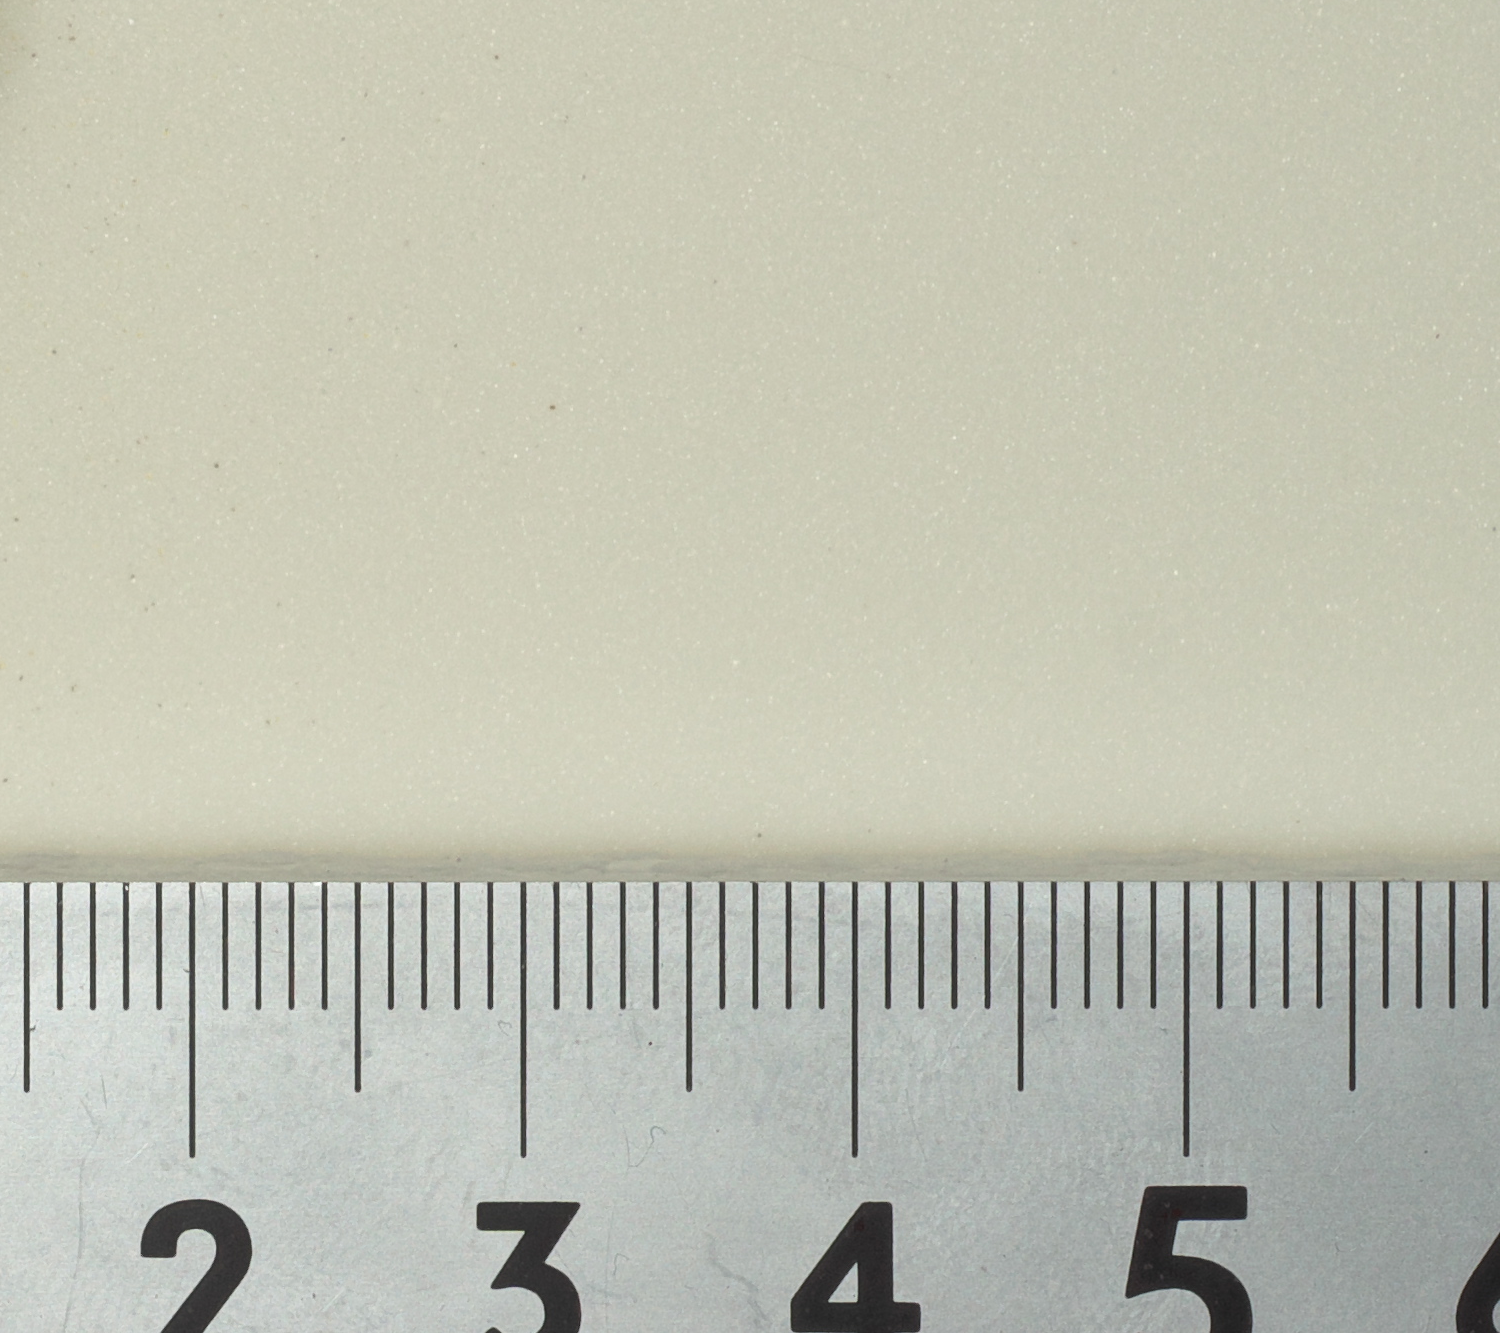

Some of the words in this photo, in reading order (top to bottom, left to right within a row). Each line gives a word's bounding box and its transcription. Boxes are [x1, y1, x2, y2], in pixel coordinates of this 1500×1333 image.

[139, 1197, 254, 1333] 2
[475, 1200, 583, 1333] 3
[789, 1200, 923, 1333] 4
[1123, 1184, 1255, 1333] 5
